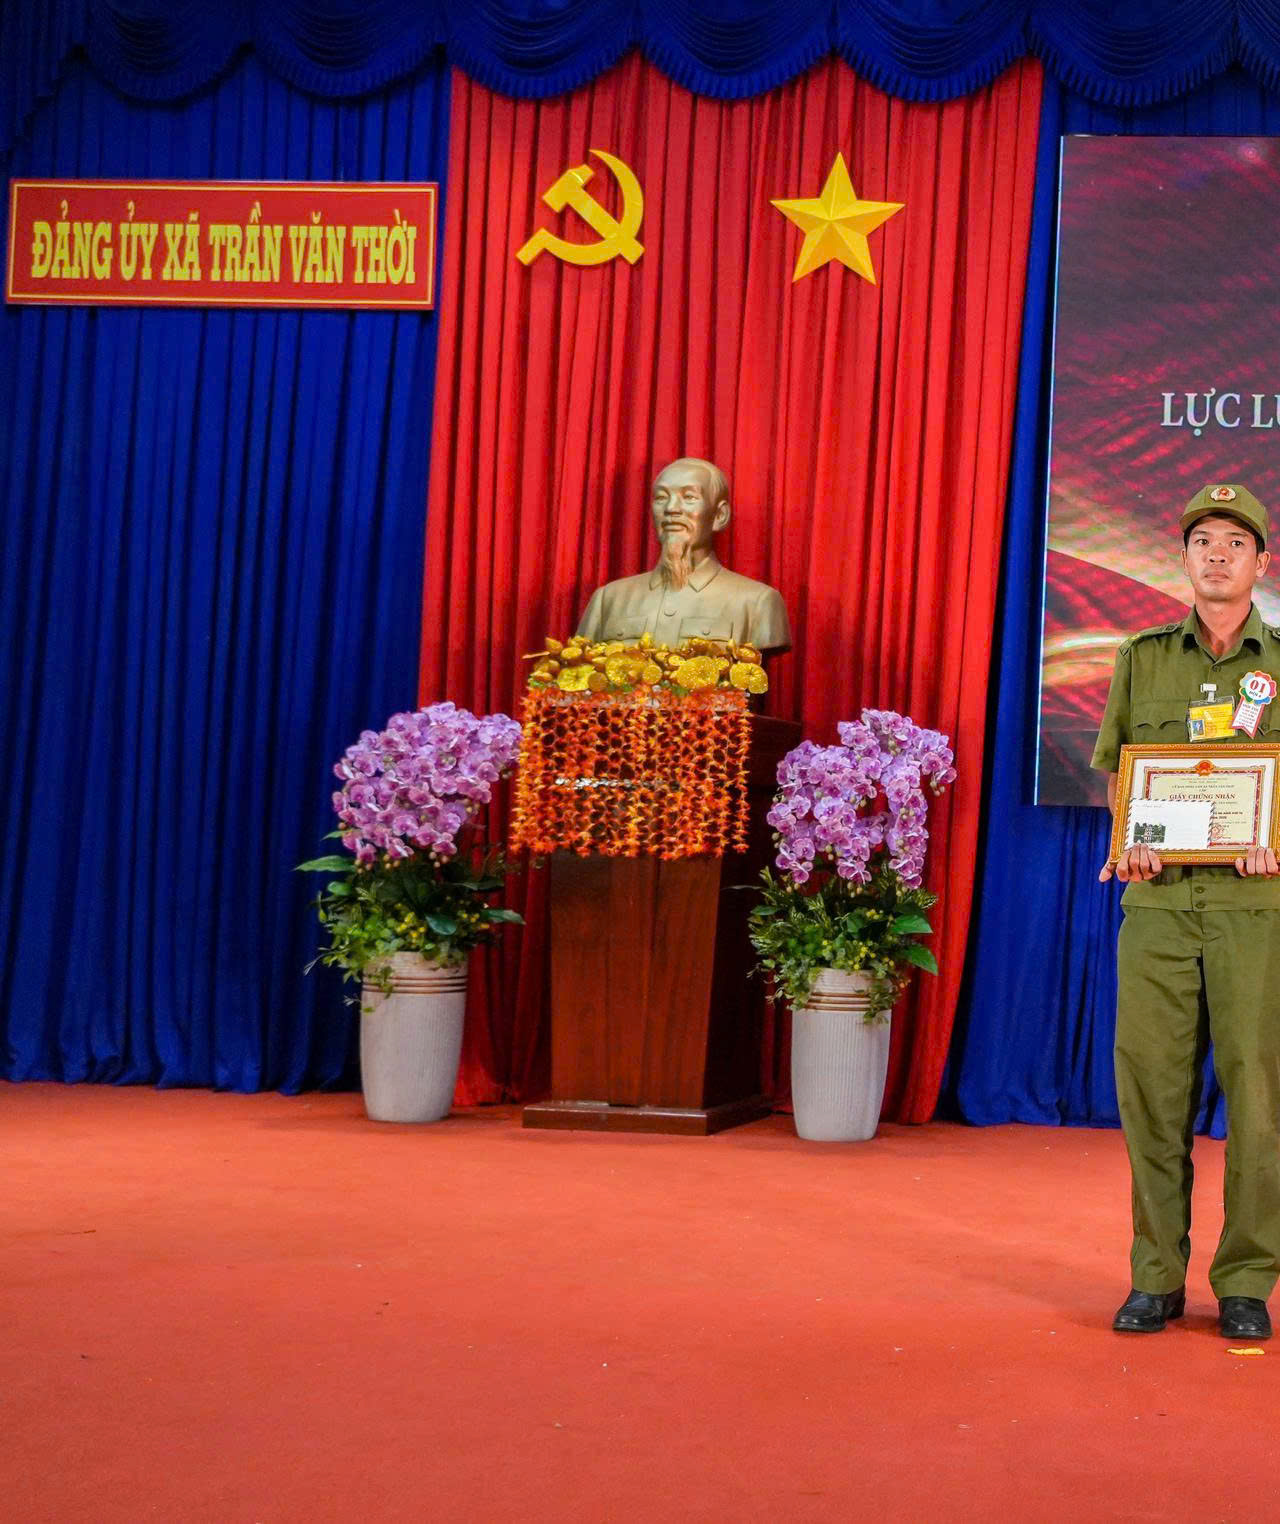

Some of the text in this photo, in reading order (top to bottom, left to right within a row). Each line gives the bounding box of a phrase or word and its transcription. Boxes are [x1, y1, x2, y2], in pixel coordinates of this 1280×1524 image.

[31, 200, 418, 285] ĐẢNG ỦY XÃ TRẦN VĂN THỜI
[1160, 388, 1242, 437] LỰC
[1250, 679, 1266, 694] 01
[1188, 792, 1214, 800] CHỨNG
[1215, 793, 1236, 801] NHẬN
